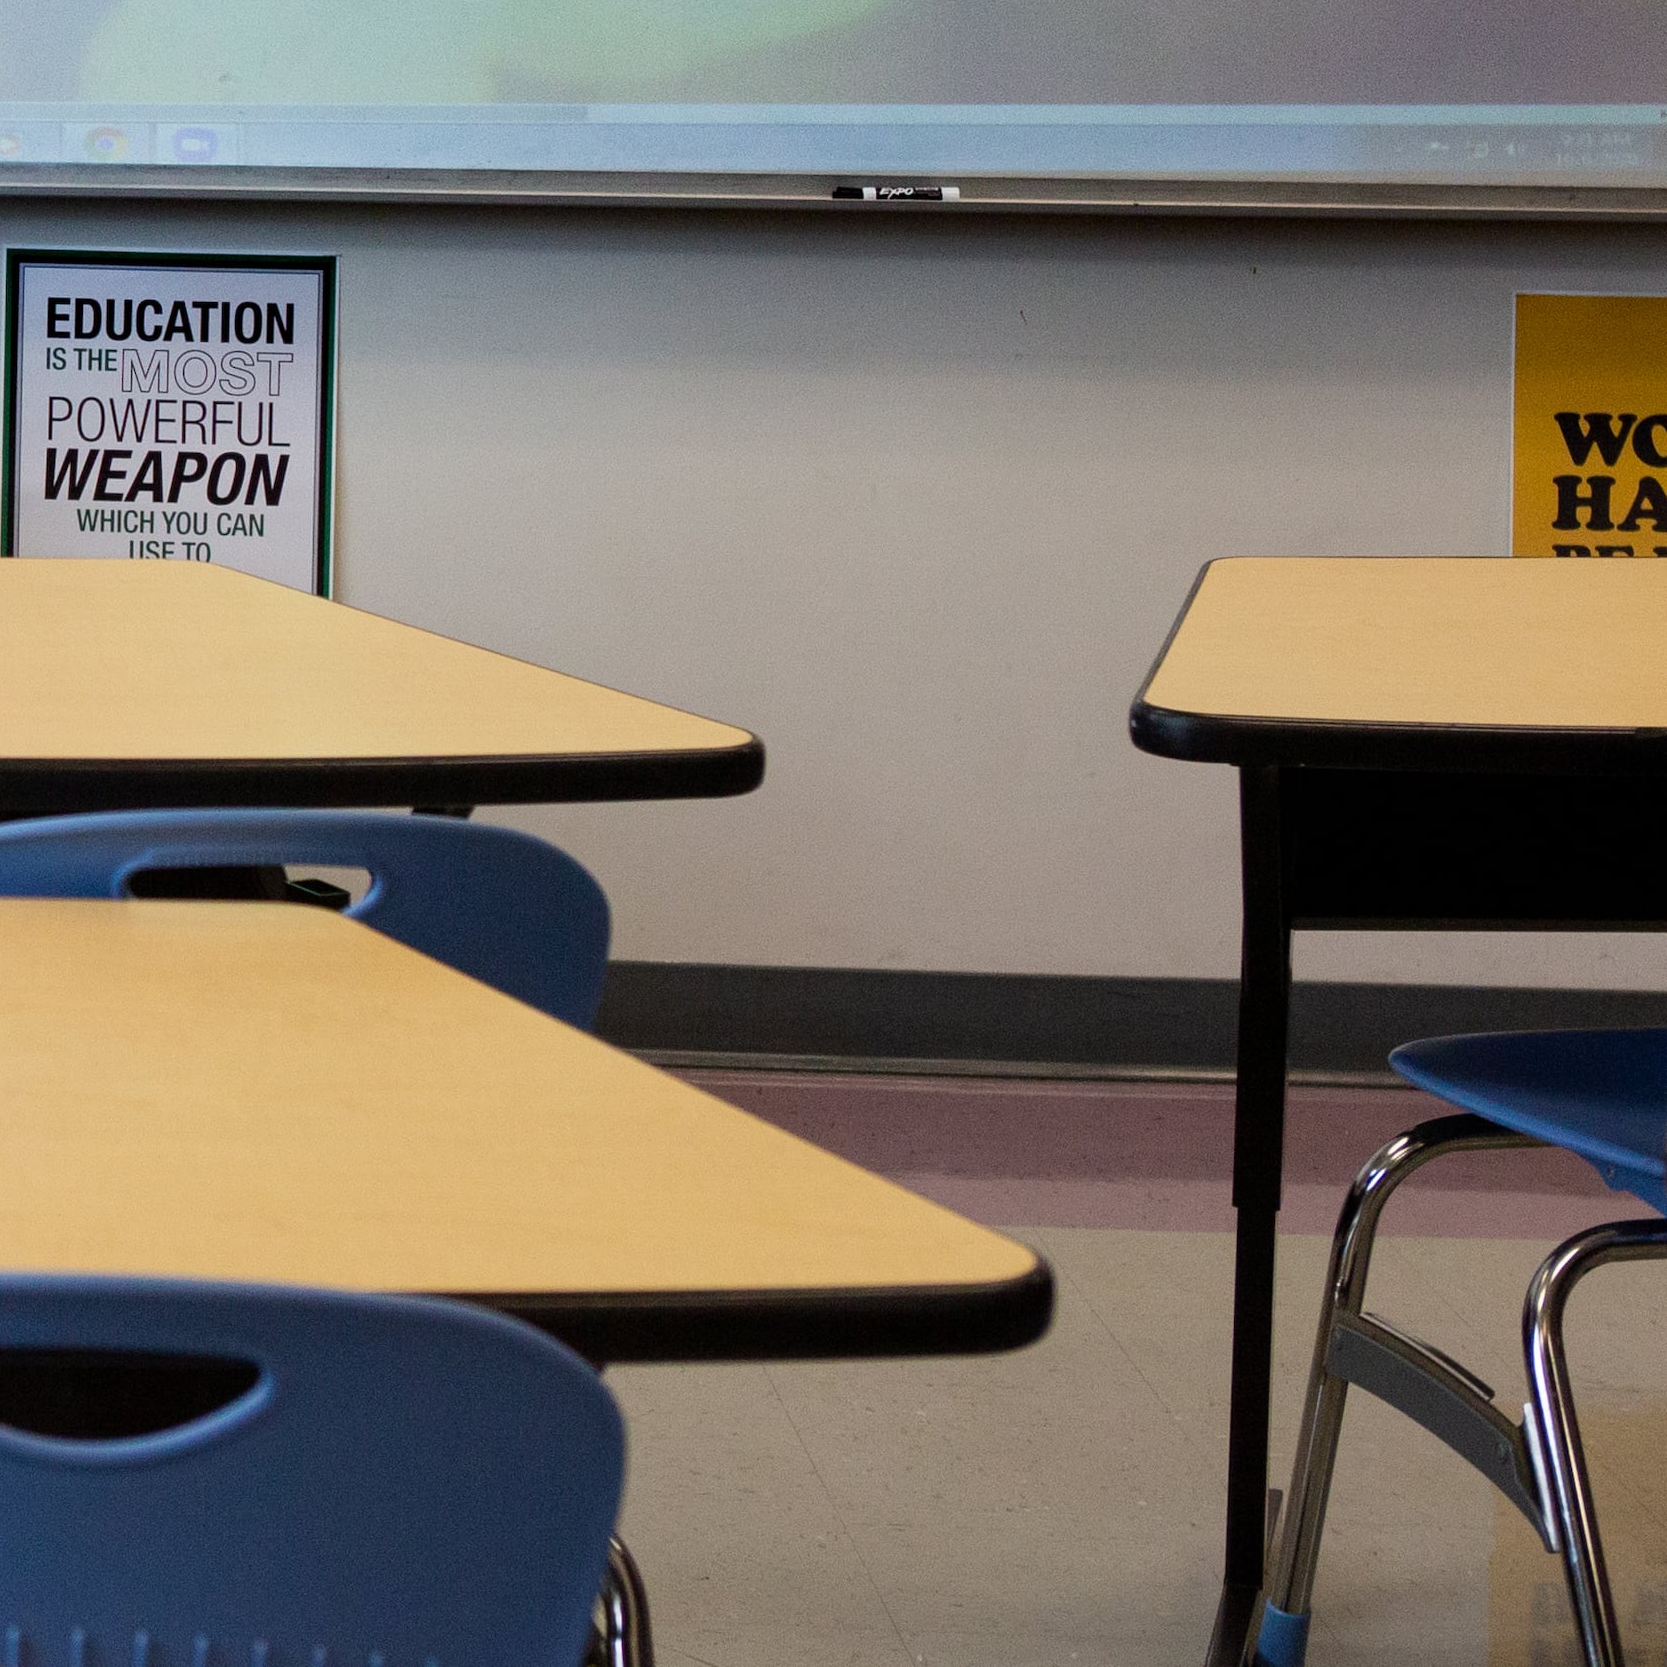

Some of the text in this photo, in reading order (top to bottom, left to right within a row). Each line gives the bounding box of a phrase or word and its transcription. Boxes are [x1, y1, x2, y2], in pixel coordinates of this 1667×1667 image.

[878, 186, 914, 200] EXPO
[46, 296, 295, 346] EDUCATION
[46, 347, 294, 397] IS THE MOST
[47, 396, 291, 448] POWERFUL
[1553, 411, 1667, 468] WO
[44, 447, 291, 507] WEAPON
[76, 509, 265, 537] WHICH YOU CAN
[1551, 474, 1667, 533] HA
[129, 540, 212, 563] USE TO
